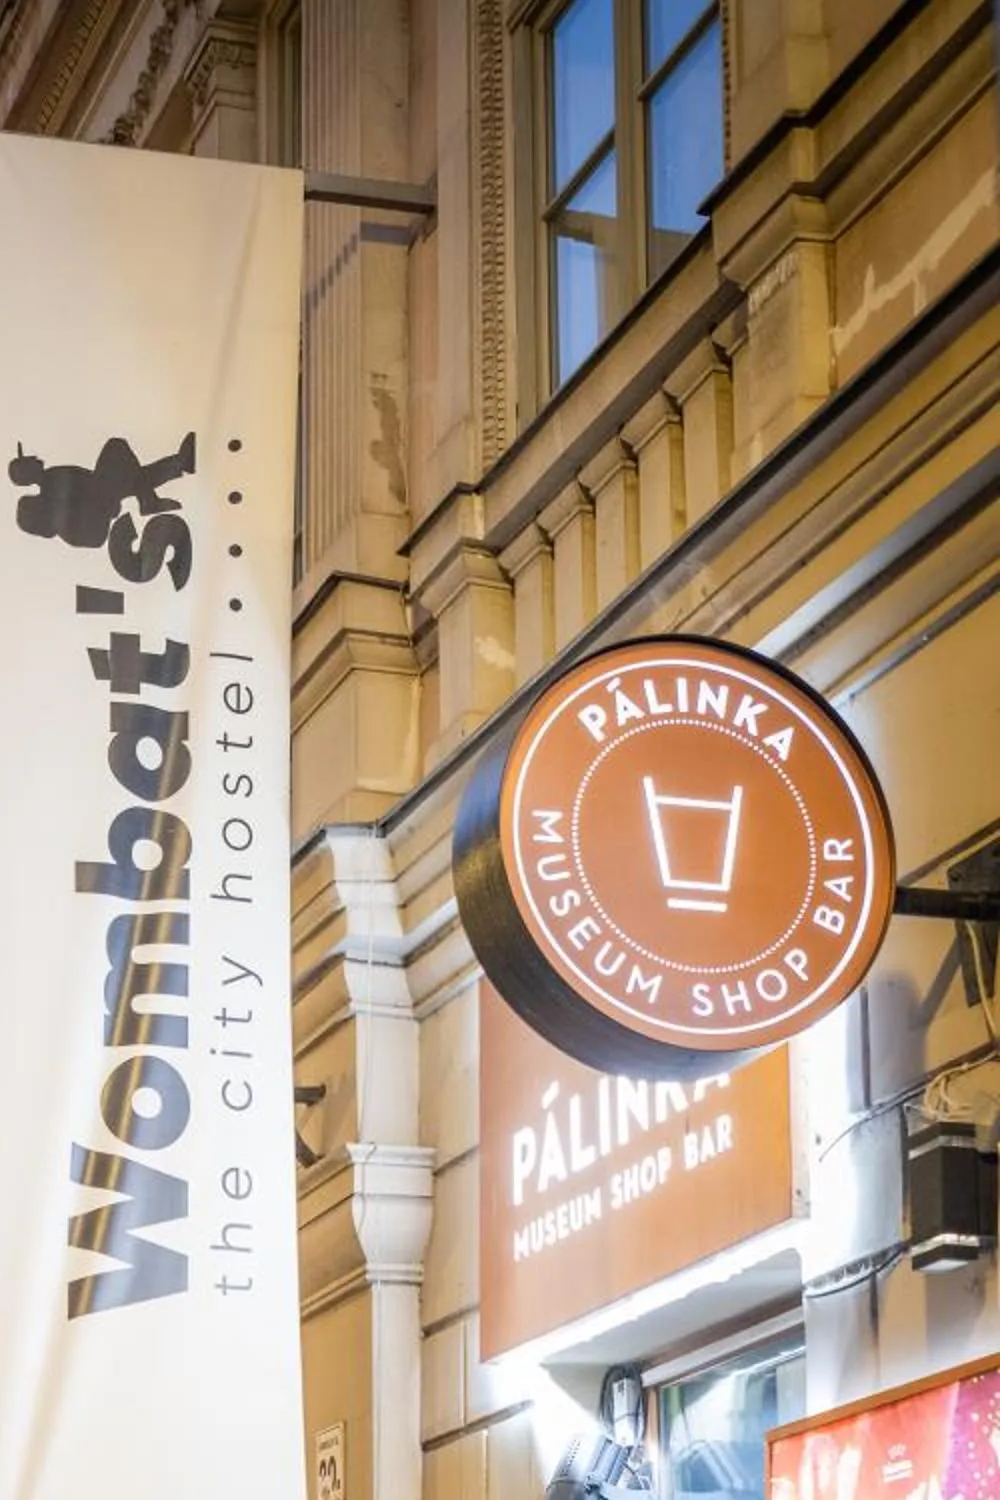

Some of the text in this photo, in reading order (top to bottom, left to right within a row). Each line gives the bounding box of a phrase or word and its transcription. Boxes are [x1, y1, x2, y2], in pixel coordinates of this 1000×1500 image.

[577, 677, 795, 762] PÁLINKA
[67, 512, 194, 1320] Wombat's
[531, 809, 855, 1017] MUSEUM SHOP BAR
[209, 954, 263, 1112] city
[512, 1072, 731, 1207] PÁLIN
[513, 1114, 733, 1262] MUSEUM SHOP BAR
[214, 1164, 254, 1296] the
